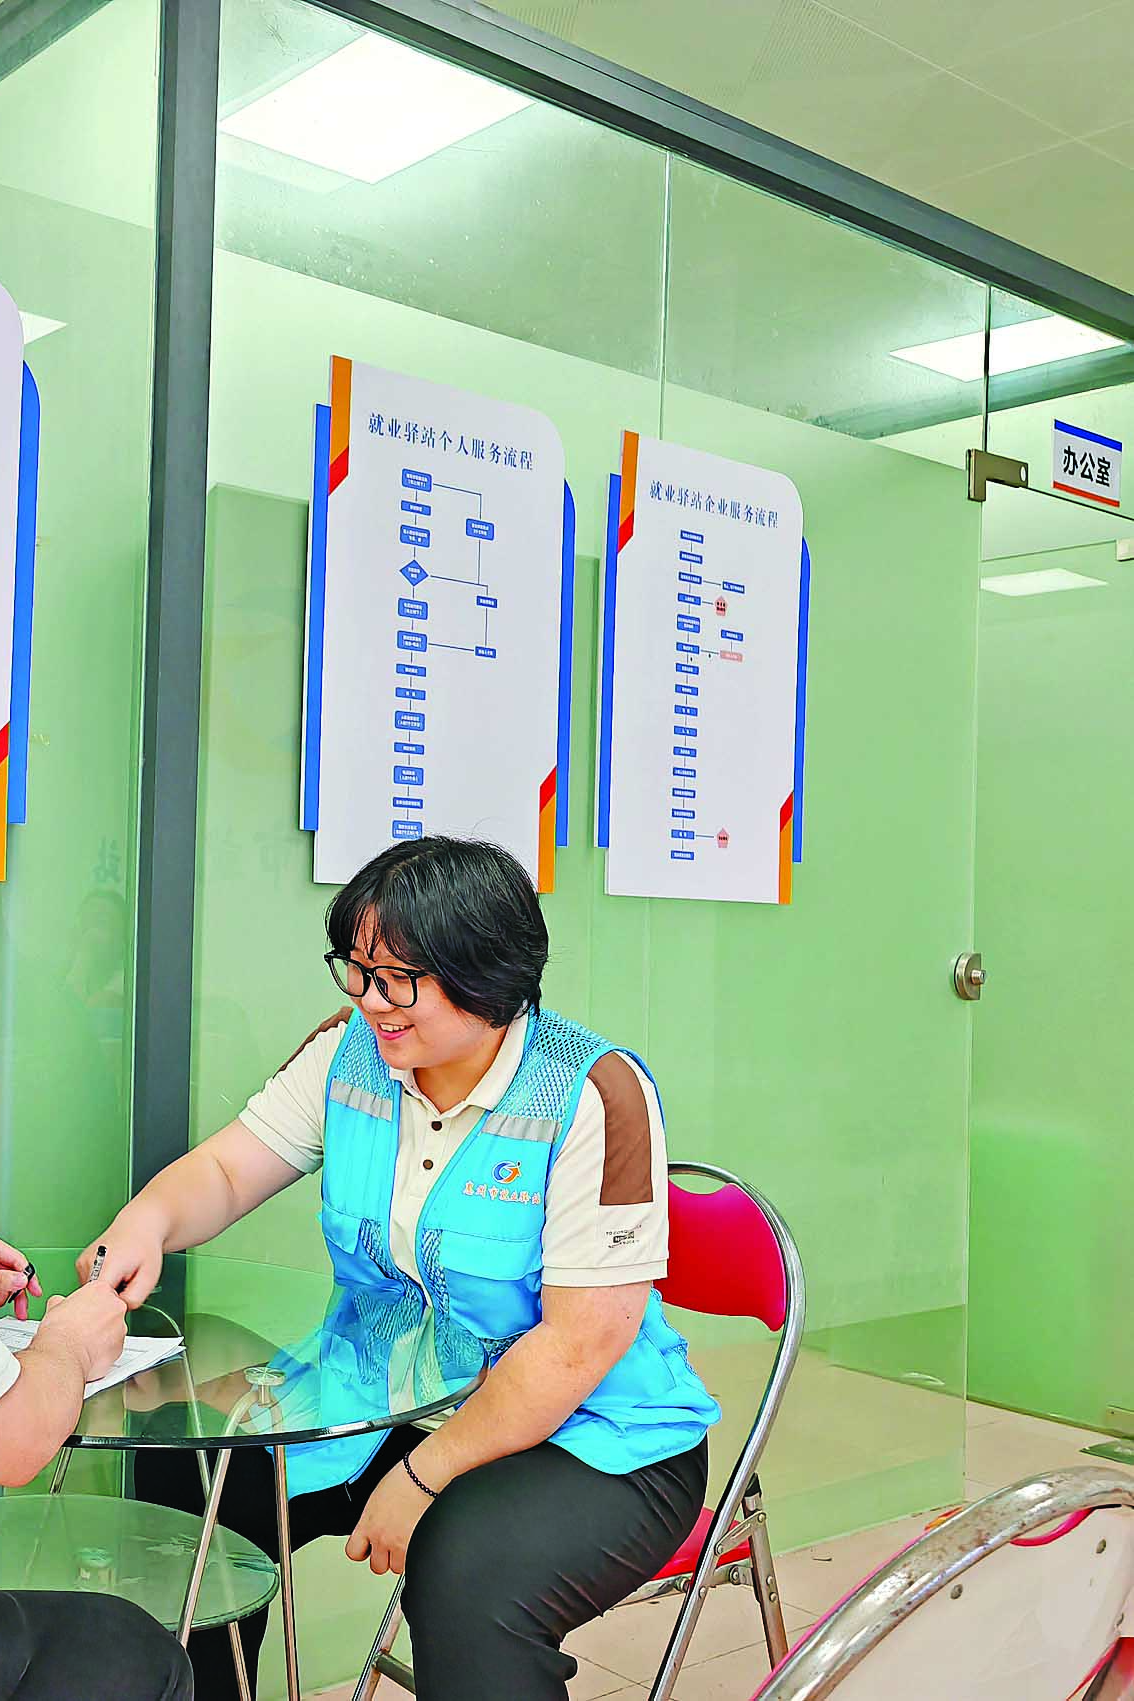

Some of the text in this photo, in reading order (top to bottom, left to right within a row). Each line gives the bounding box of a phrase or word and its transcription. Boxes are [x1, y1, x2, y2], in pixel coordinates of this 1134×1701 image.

[368, 412, 533, 471] 就业驿站个人服务流程
[1063, 445, 1111, 487] 办公室
[649, 480, 778, 528] 就业驿站企业服务流程
